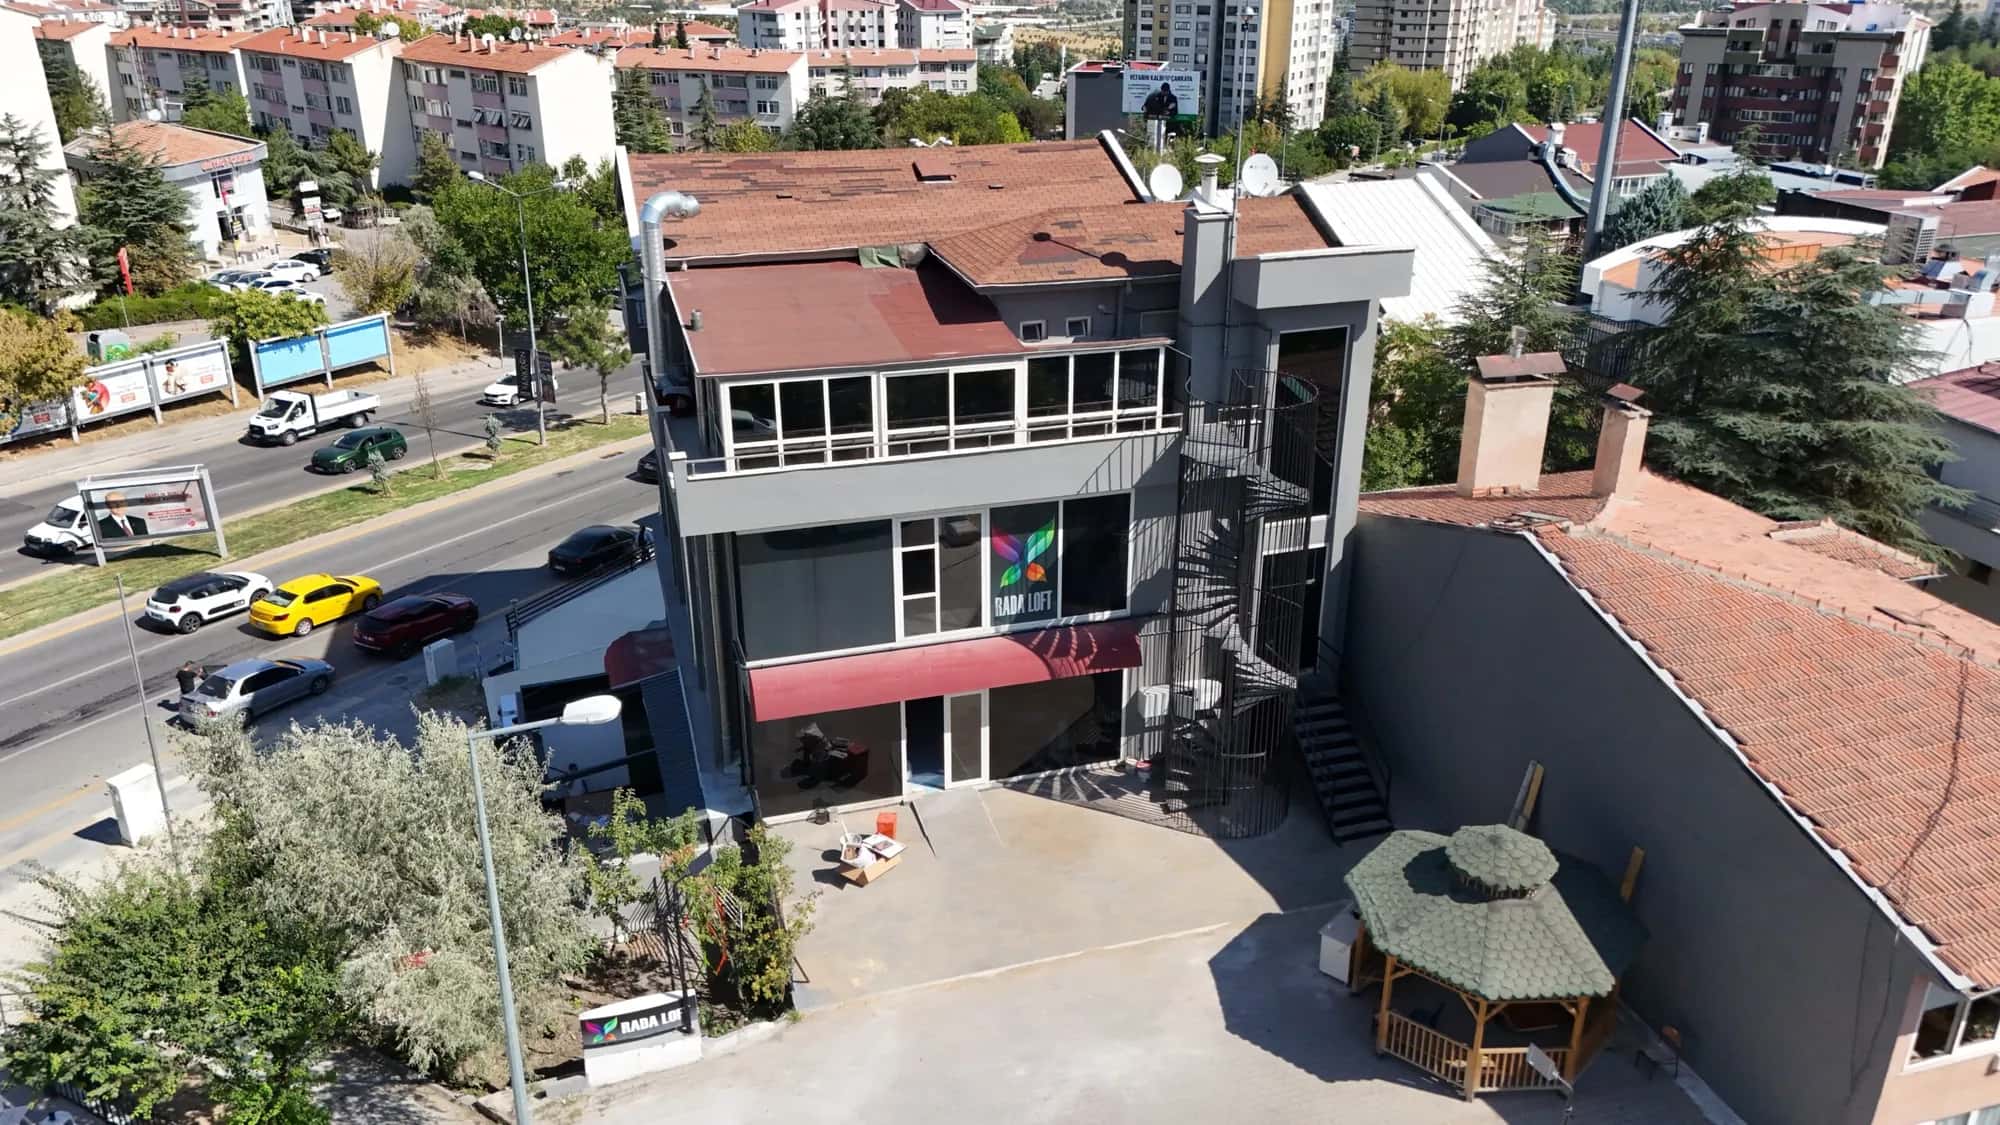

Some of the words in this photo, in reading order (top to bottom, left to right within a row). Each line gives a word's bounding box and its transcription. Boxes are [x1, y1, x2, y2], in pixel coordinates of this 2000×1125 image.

[995, 594, 1025, 617] RADA
[1028, 590, 1053, 612] LOFT
[620, 1015, 659, 1034] RADA
[660, 1007, 682, 1025] LOF
